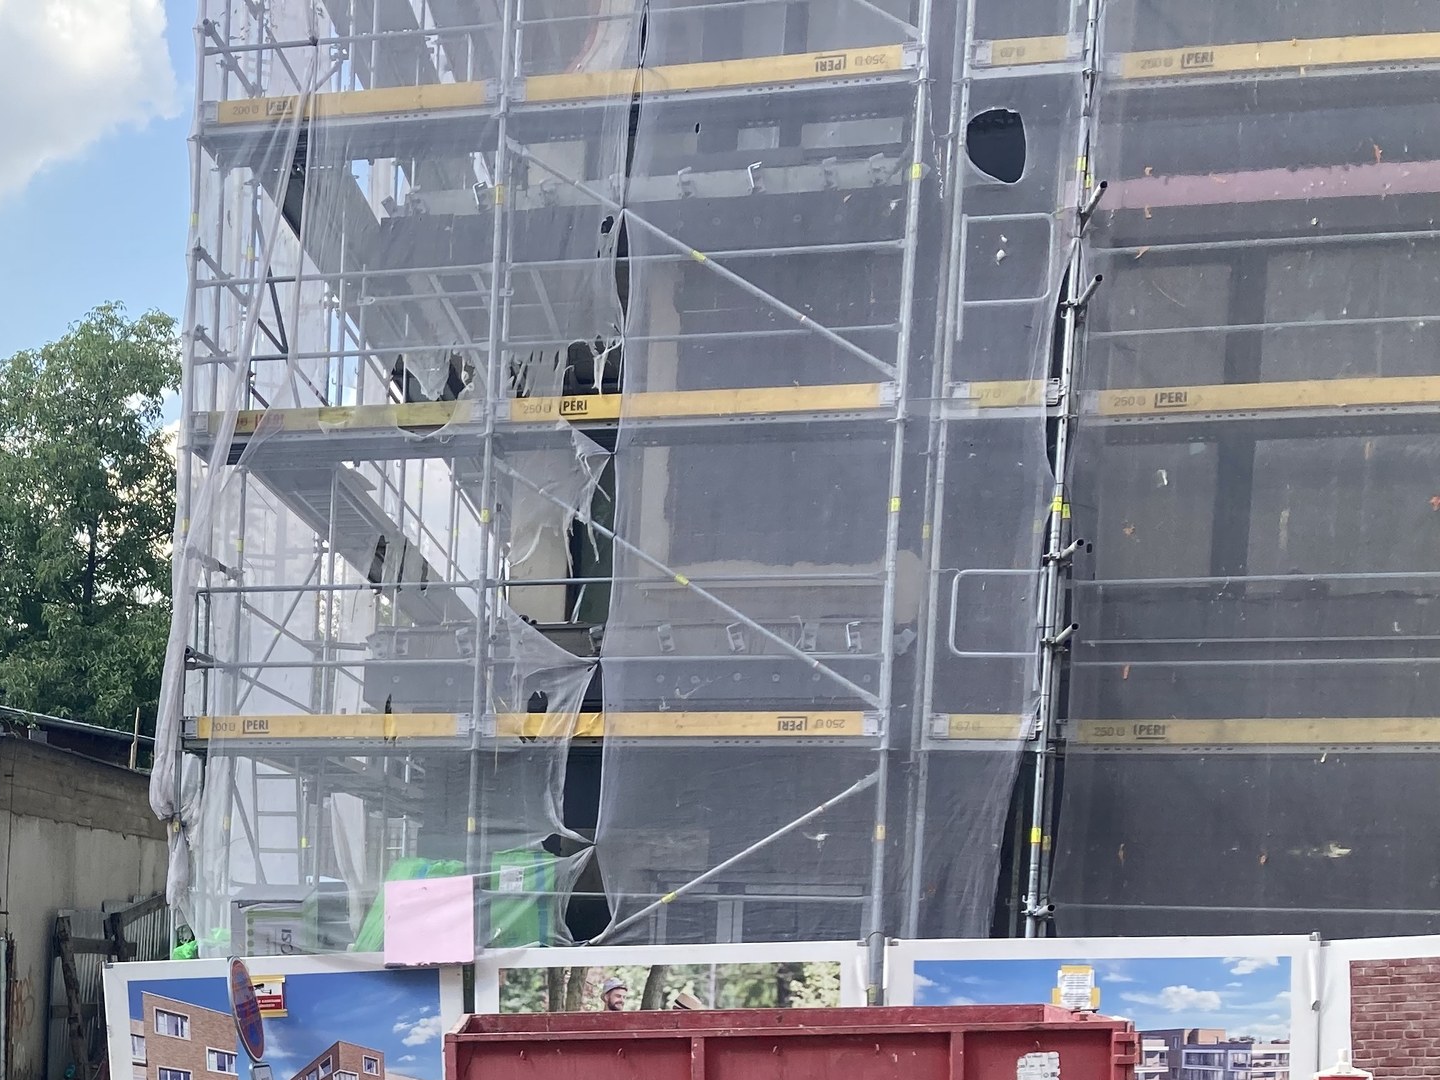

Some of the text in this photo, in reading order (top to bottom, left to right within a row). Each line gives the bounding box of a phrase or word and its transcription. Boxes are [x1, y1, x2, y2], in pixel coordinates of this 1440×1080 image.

[1186, 51, 1214, 65] PERI
[815, 58, 842, 73] PERI
[1159, 391, 1188, 404] PERI
[563, 399, 588, 412] PERI
[246, 719, 269, 731] PERI
[777, 720, 803, 732] PERI
[1138, 724, 1166, 736] PERI
